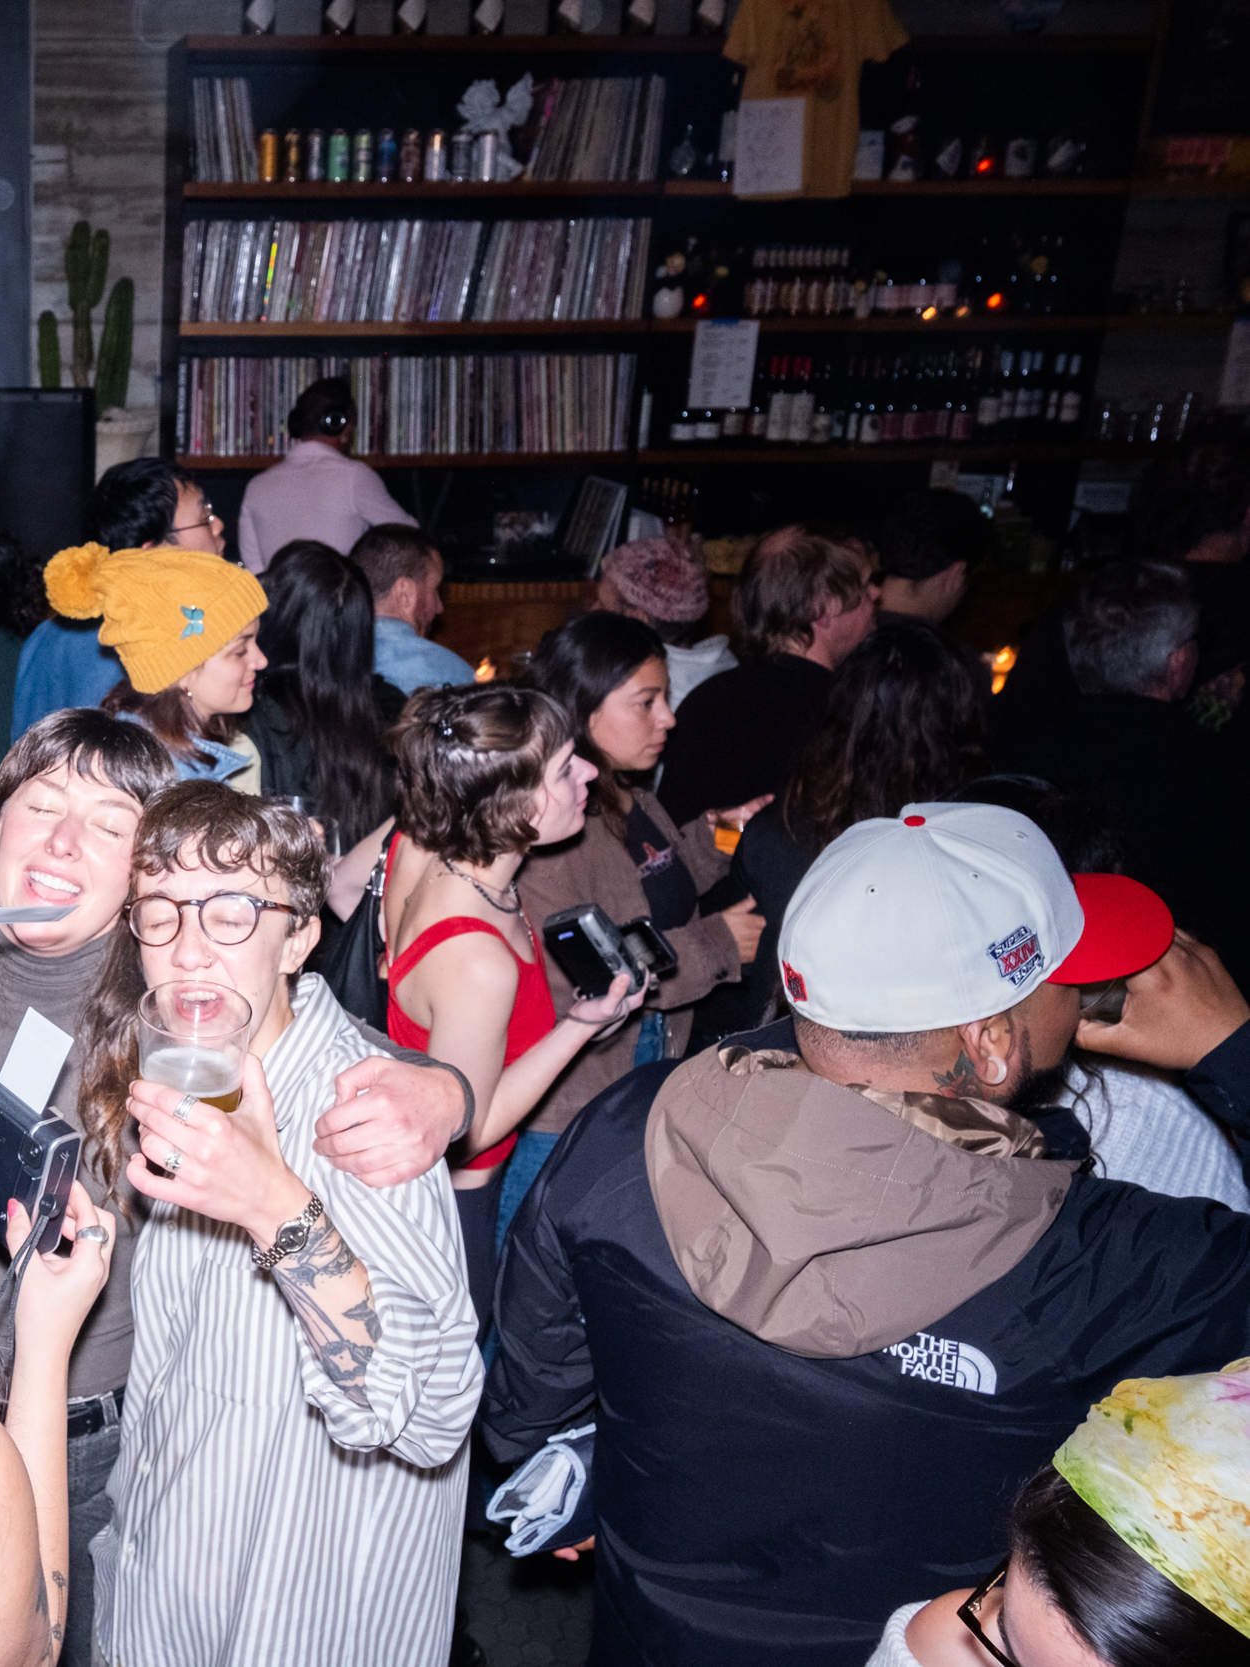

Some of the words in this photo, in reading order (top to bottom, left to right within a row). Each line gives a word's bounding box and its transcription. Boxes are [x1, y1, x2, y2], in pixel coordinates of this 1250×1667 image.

[994, 926, 1028, 957] SUPER
[999, 938, 1036, 974] XXIV
[1012, 955, 1042, 985] BOWL
[916, 1331, 958, 1356] THE
[900, 1357, 956, 1387] FACE
